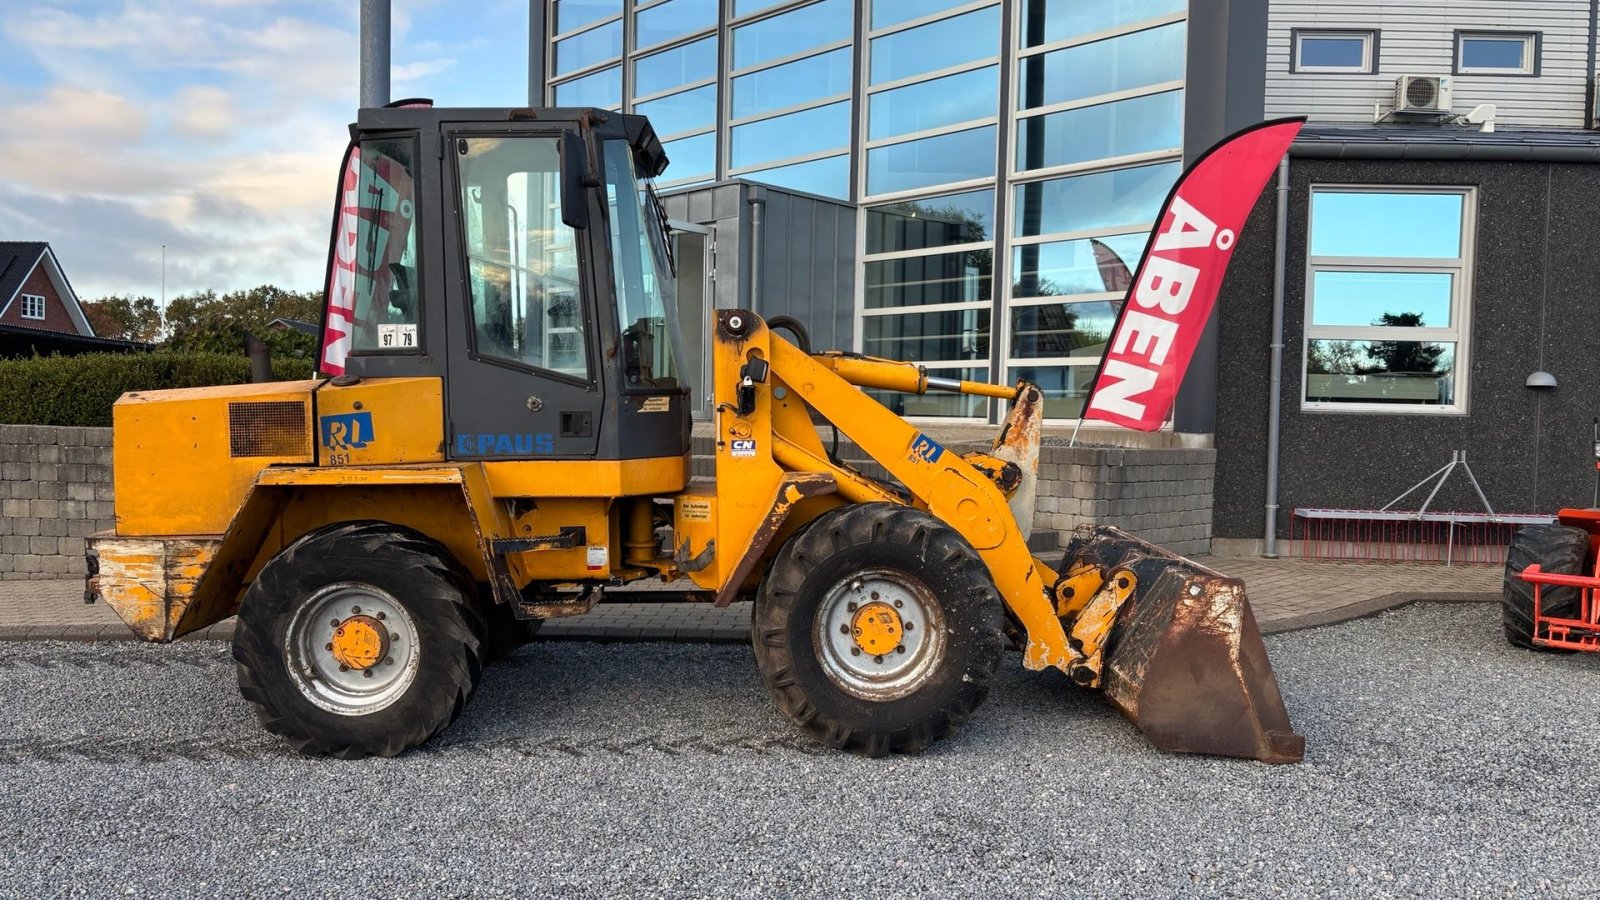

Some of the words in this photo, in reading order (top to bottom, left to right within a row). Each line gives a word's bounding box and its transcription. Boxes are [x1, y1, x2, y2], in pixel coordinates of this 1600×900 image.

[1090, 195, 1234, 421] ÅBEN
[383, 334, 392, 346] 97
[403, 333, 412, 346] 79
[733, 440, 753, 449] CN
[329, 453, 350, 465] 851
[908, 455, 920, 465] 851
